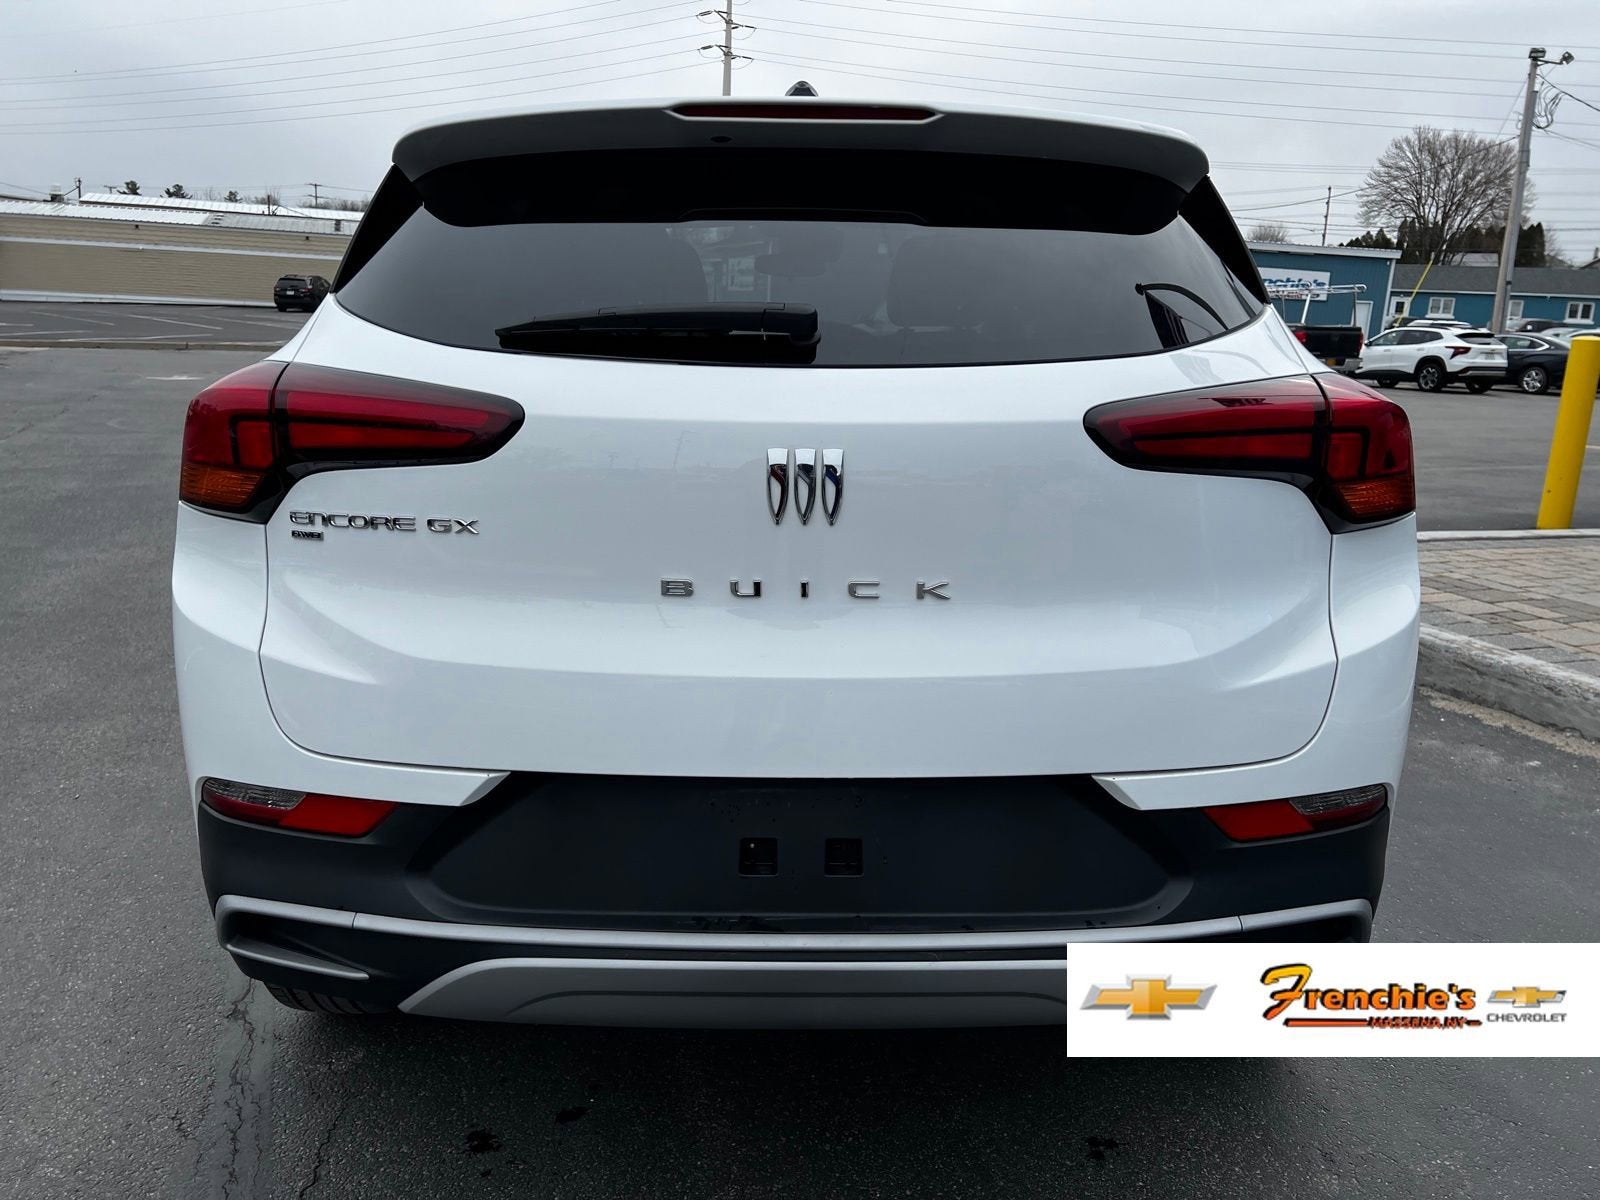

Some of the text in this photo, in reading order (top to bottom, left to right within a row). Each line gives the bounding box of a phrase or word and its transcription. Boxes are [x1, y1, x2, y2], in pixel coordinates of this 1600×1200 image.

[289, 511, 479, 534] ENCORE GX
[660, 578, 951, 600] BUICK
